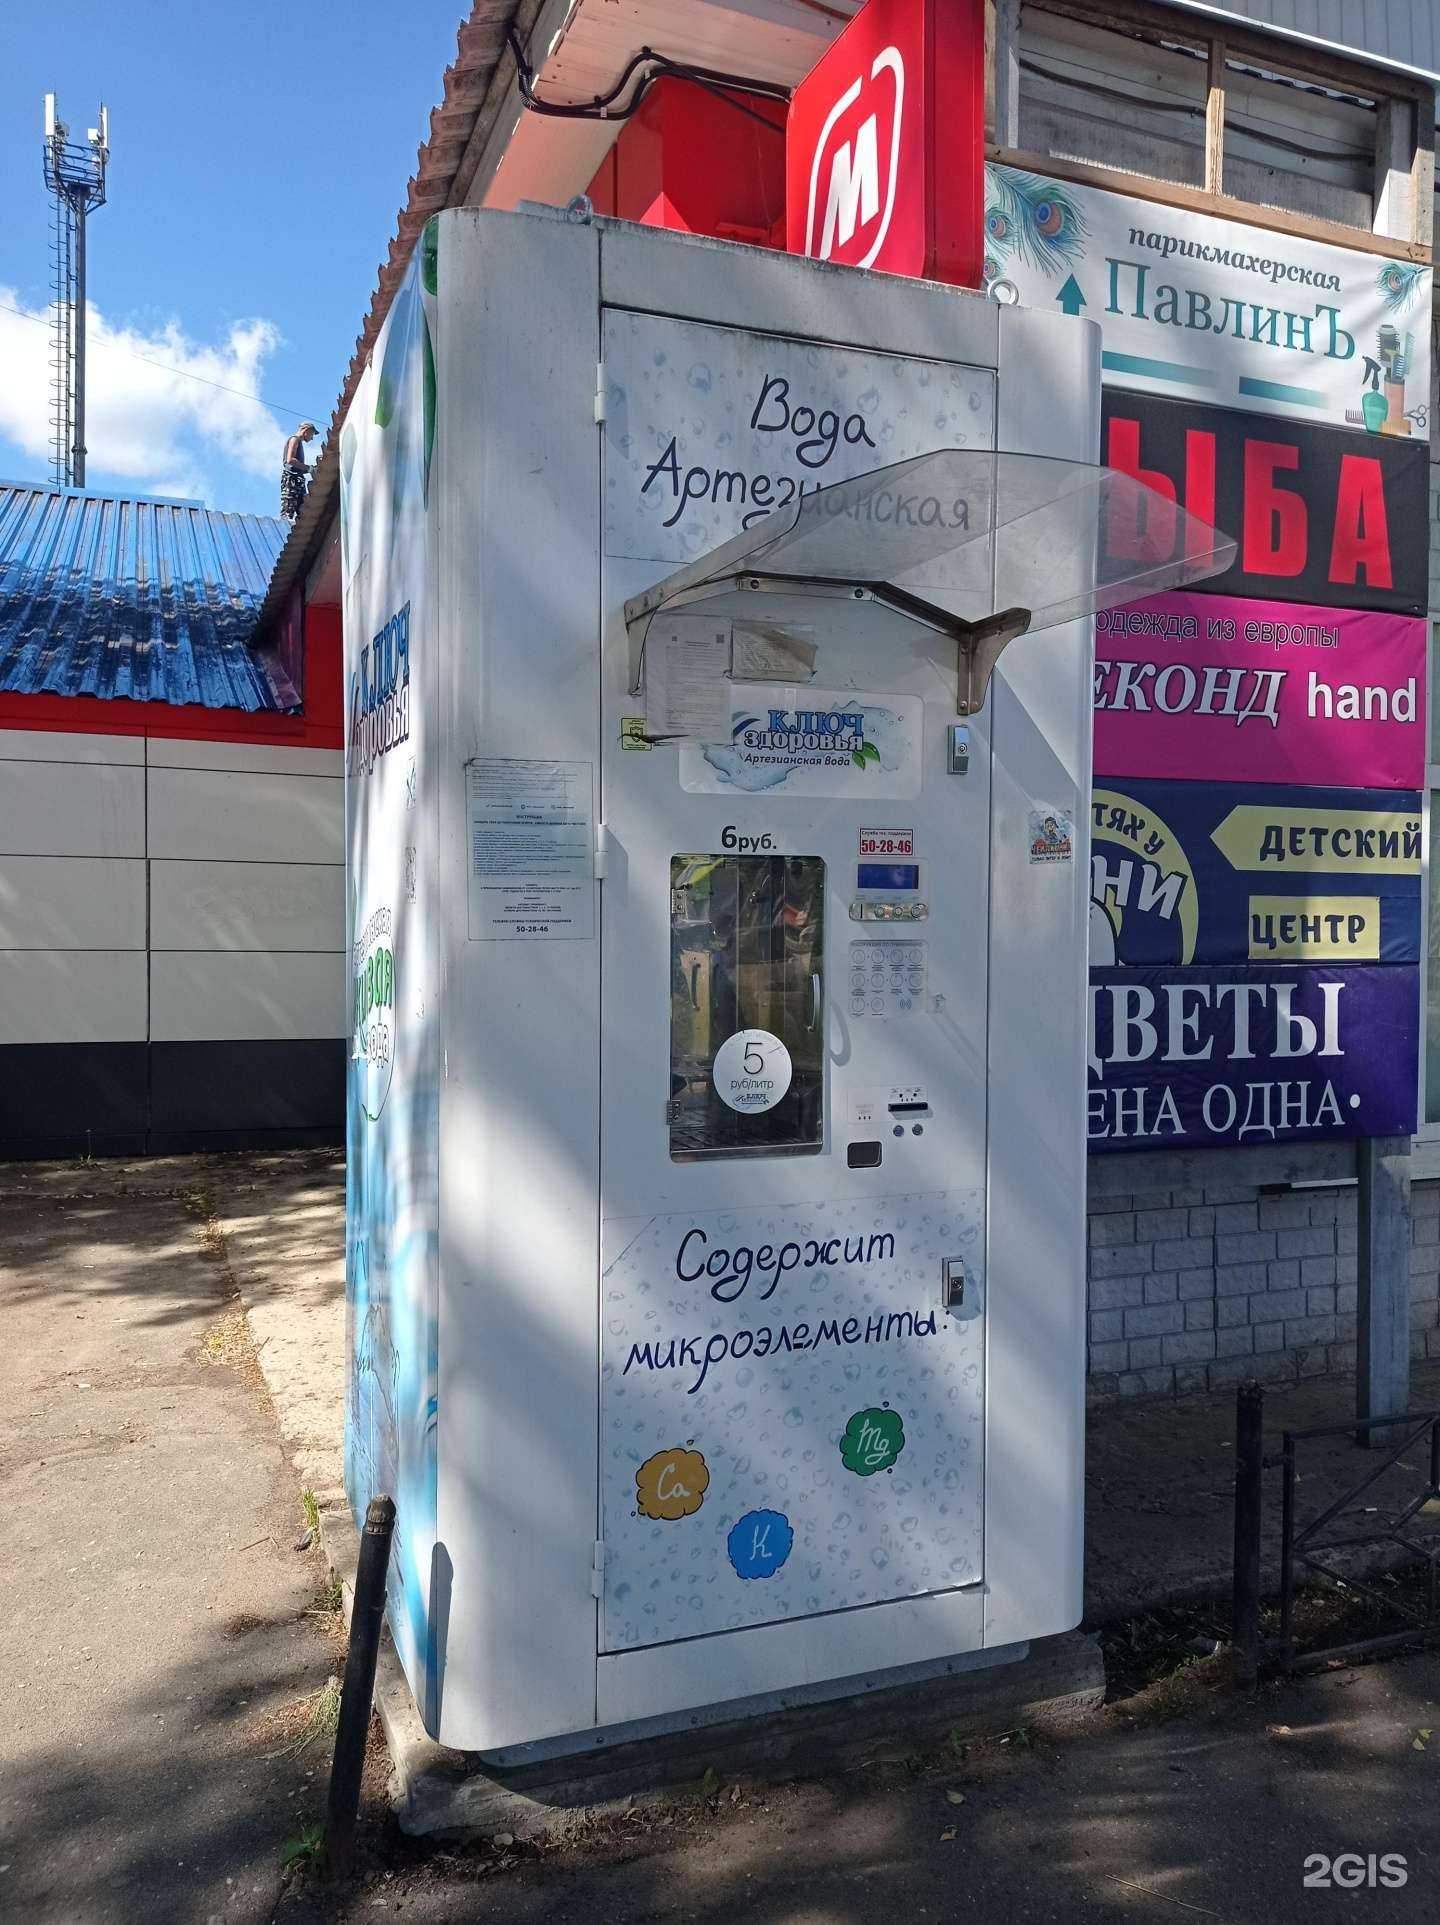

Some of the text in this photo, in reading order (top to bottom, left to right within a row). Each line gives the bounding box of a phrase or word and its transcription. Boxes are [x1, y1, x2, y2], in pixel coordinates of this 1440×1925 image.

[1128, 224, 1342, 292] парикмахерская
[1104, 256, 1357, 362] ПавлинЪ
[750, 373, 876, 469] Вода
[1106, 416, 1394, 590] ЫБА
[1095, 609, 1340, 652] одежда из европы
[1093, 659, 1417, 728] ЕКОНД hand
[744, 753, 822, 766] Артезианская
[1091, 802, 1146, 842] ТЯХ
[1259, 821, 1422, 862] ДЕТСКИЙ
[861, 839, 912, 854] 50-28-46
[1090, 854, 1185, 920] НИ
[516, 925, 549, 933] 50-28-46
[1251, 914, 1366, 950] ЦЕНТР
[743, 1042, 764, 1075] 5
[730, 1077, 774, 1090] руб/литр
[1087, 1084, 1188, 1139] ЕНА
[676, 1228, 895, 1303] Содержит
[622, 1310, 938, 1395] микроэлементы
[857, 1418, 891, 1466] Mg
